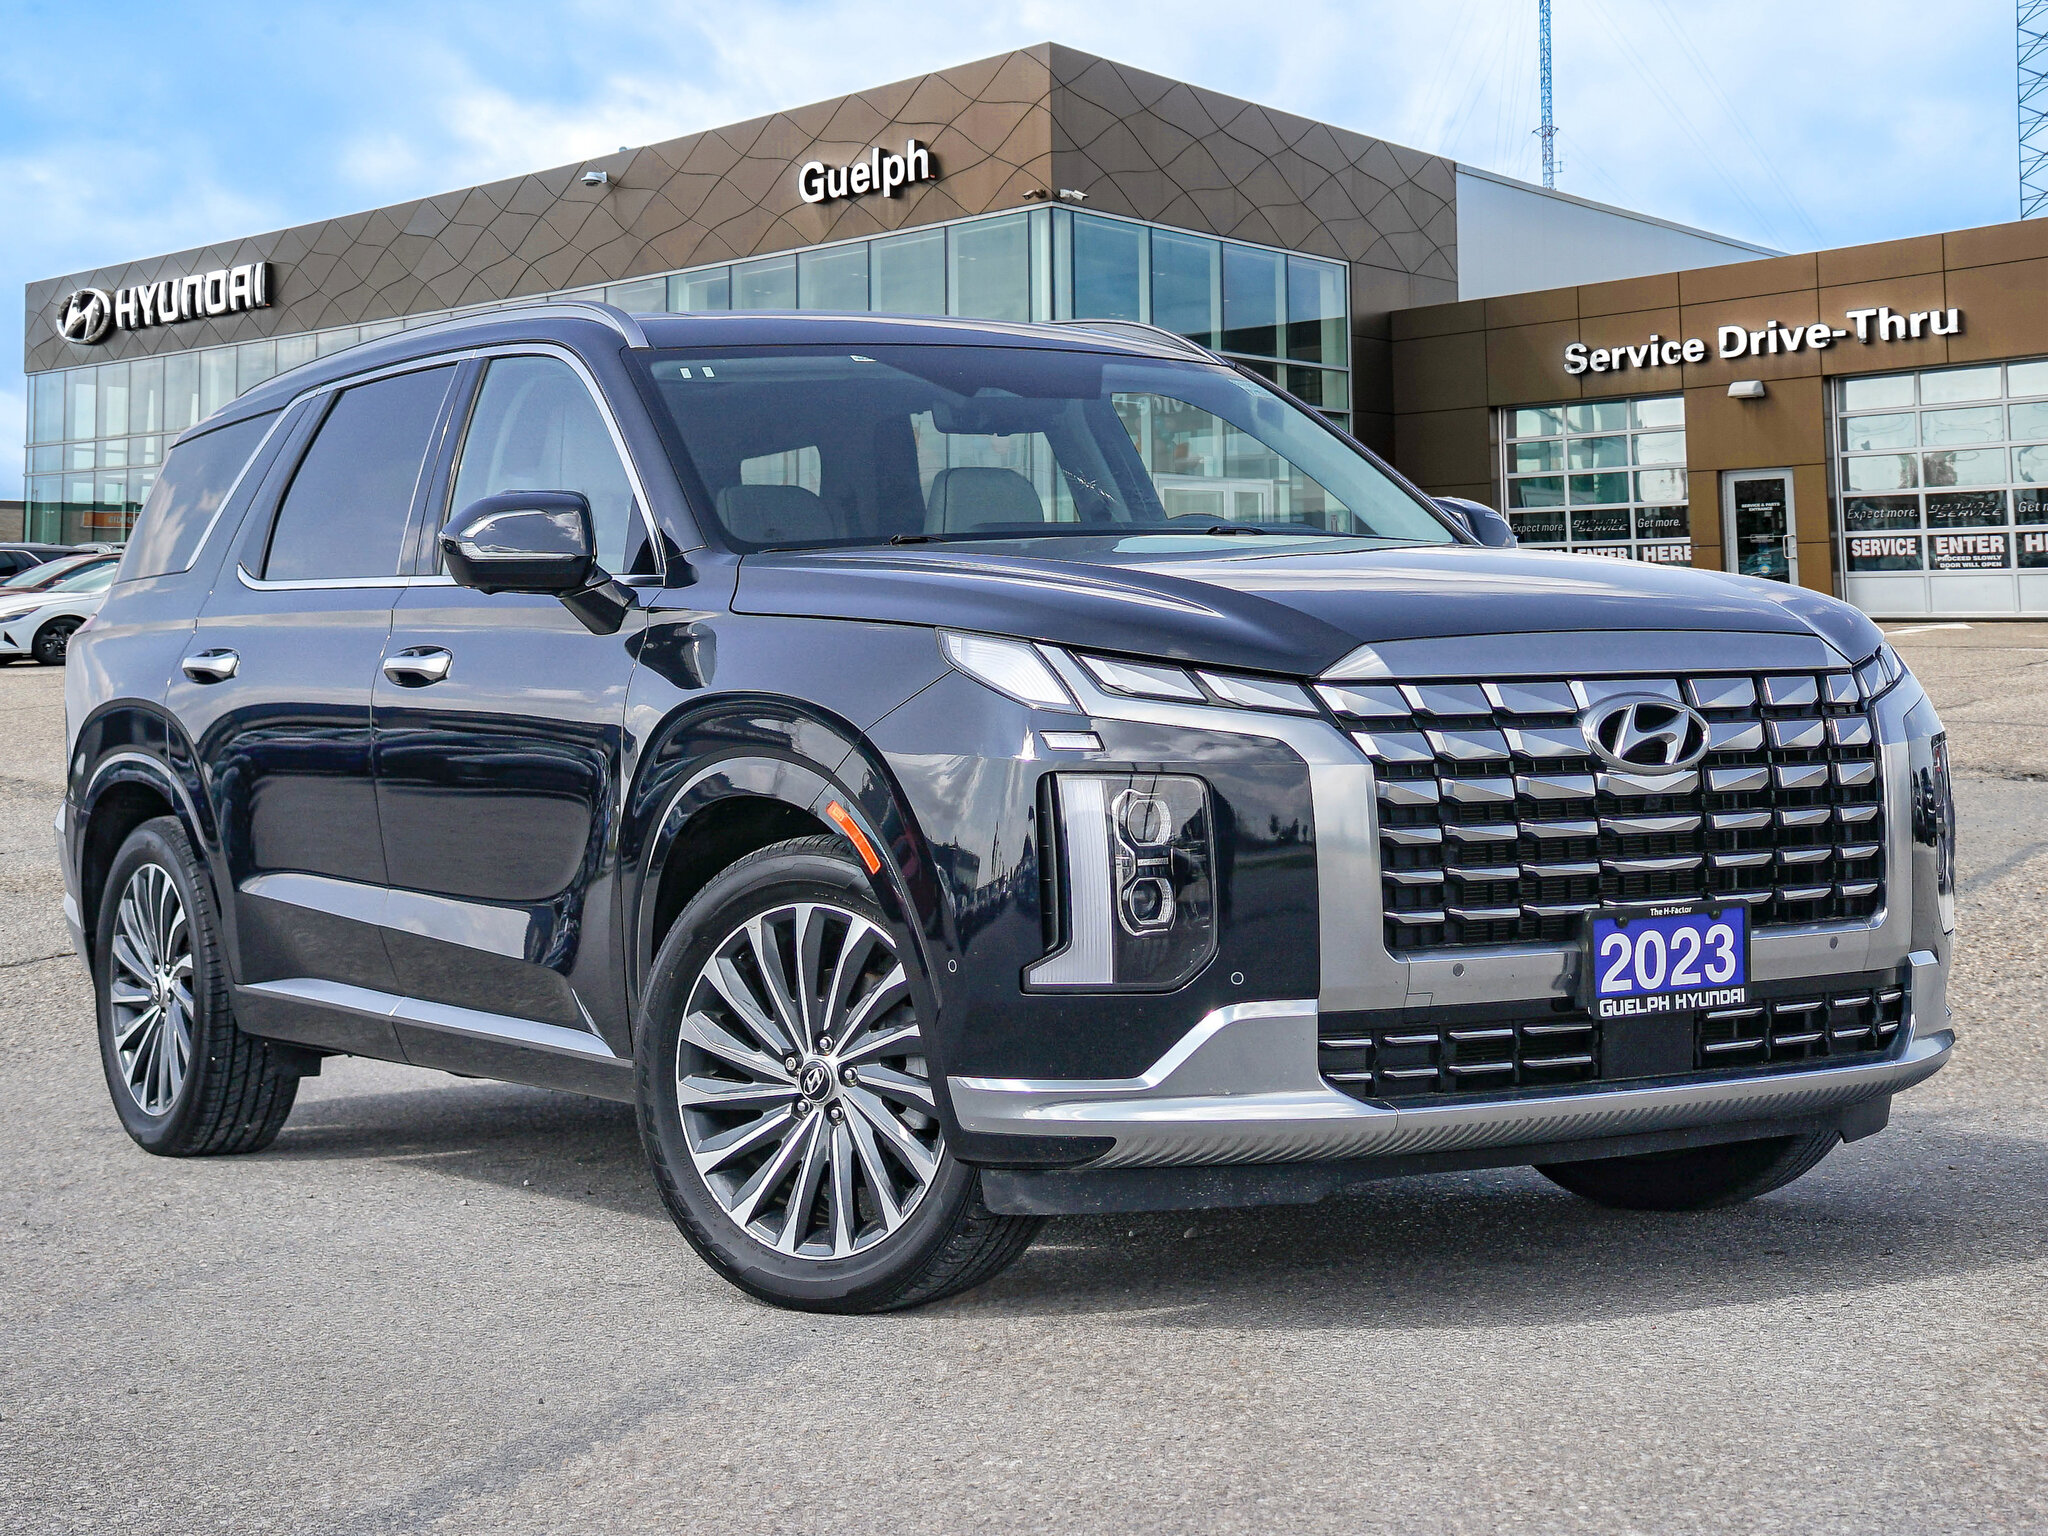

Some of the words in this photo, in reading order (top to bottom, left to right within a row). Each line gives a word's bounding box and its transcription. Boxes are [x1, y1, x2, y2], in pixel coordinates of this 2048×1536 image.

[798, 138, 929, 203] Guelph
[115, 262, 269, 330] HYUNDAI
[1563, 334, 1705, 375] Service
[1718, 306, 1962, 359] Drive-Thru
[1847, 508, 1884, 520] Expect
[1886, 508, 1918, 518] more.
[1936, 508, 2003, 518] SERVICE
[2018, 501, 2040, 512] Get
[1512, 522, 1541, 534] Expect
[1541, 523, 1565, 532] more.
[1637, 518, 1654, 528] Get
[1655, 518, 1681, 527] more.
[1643, 545, 1692, 562] HERE
[1851, 537, 1917, 557] SERVICE
[1936, 535, 2005, 554] ENTER
[1650, 907, 1663, 916] The
[1663, 906, 1692, 915] H-Factor
[1600, 923, 1737, 994] 2023
[1599, 994, 1670, 1017] GUELPH
[1675, 988, 1745, 1010] HYUNDAI
